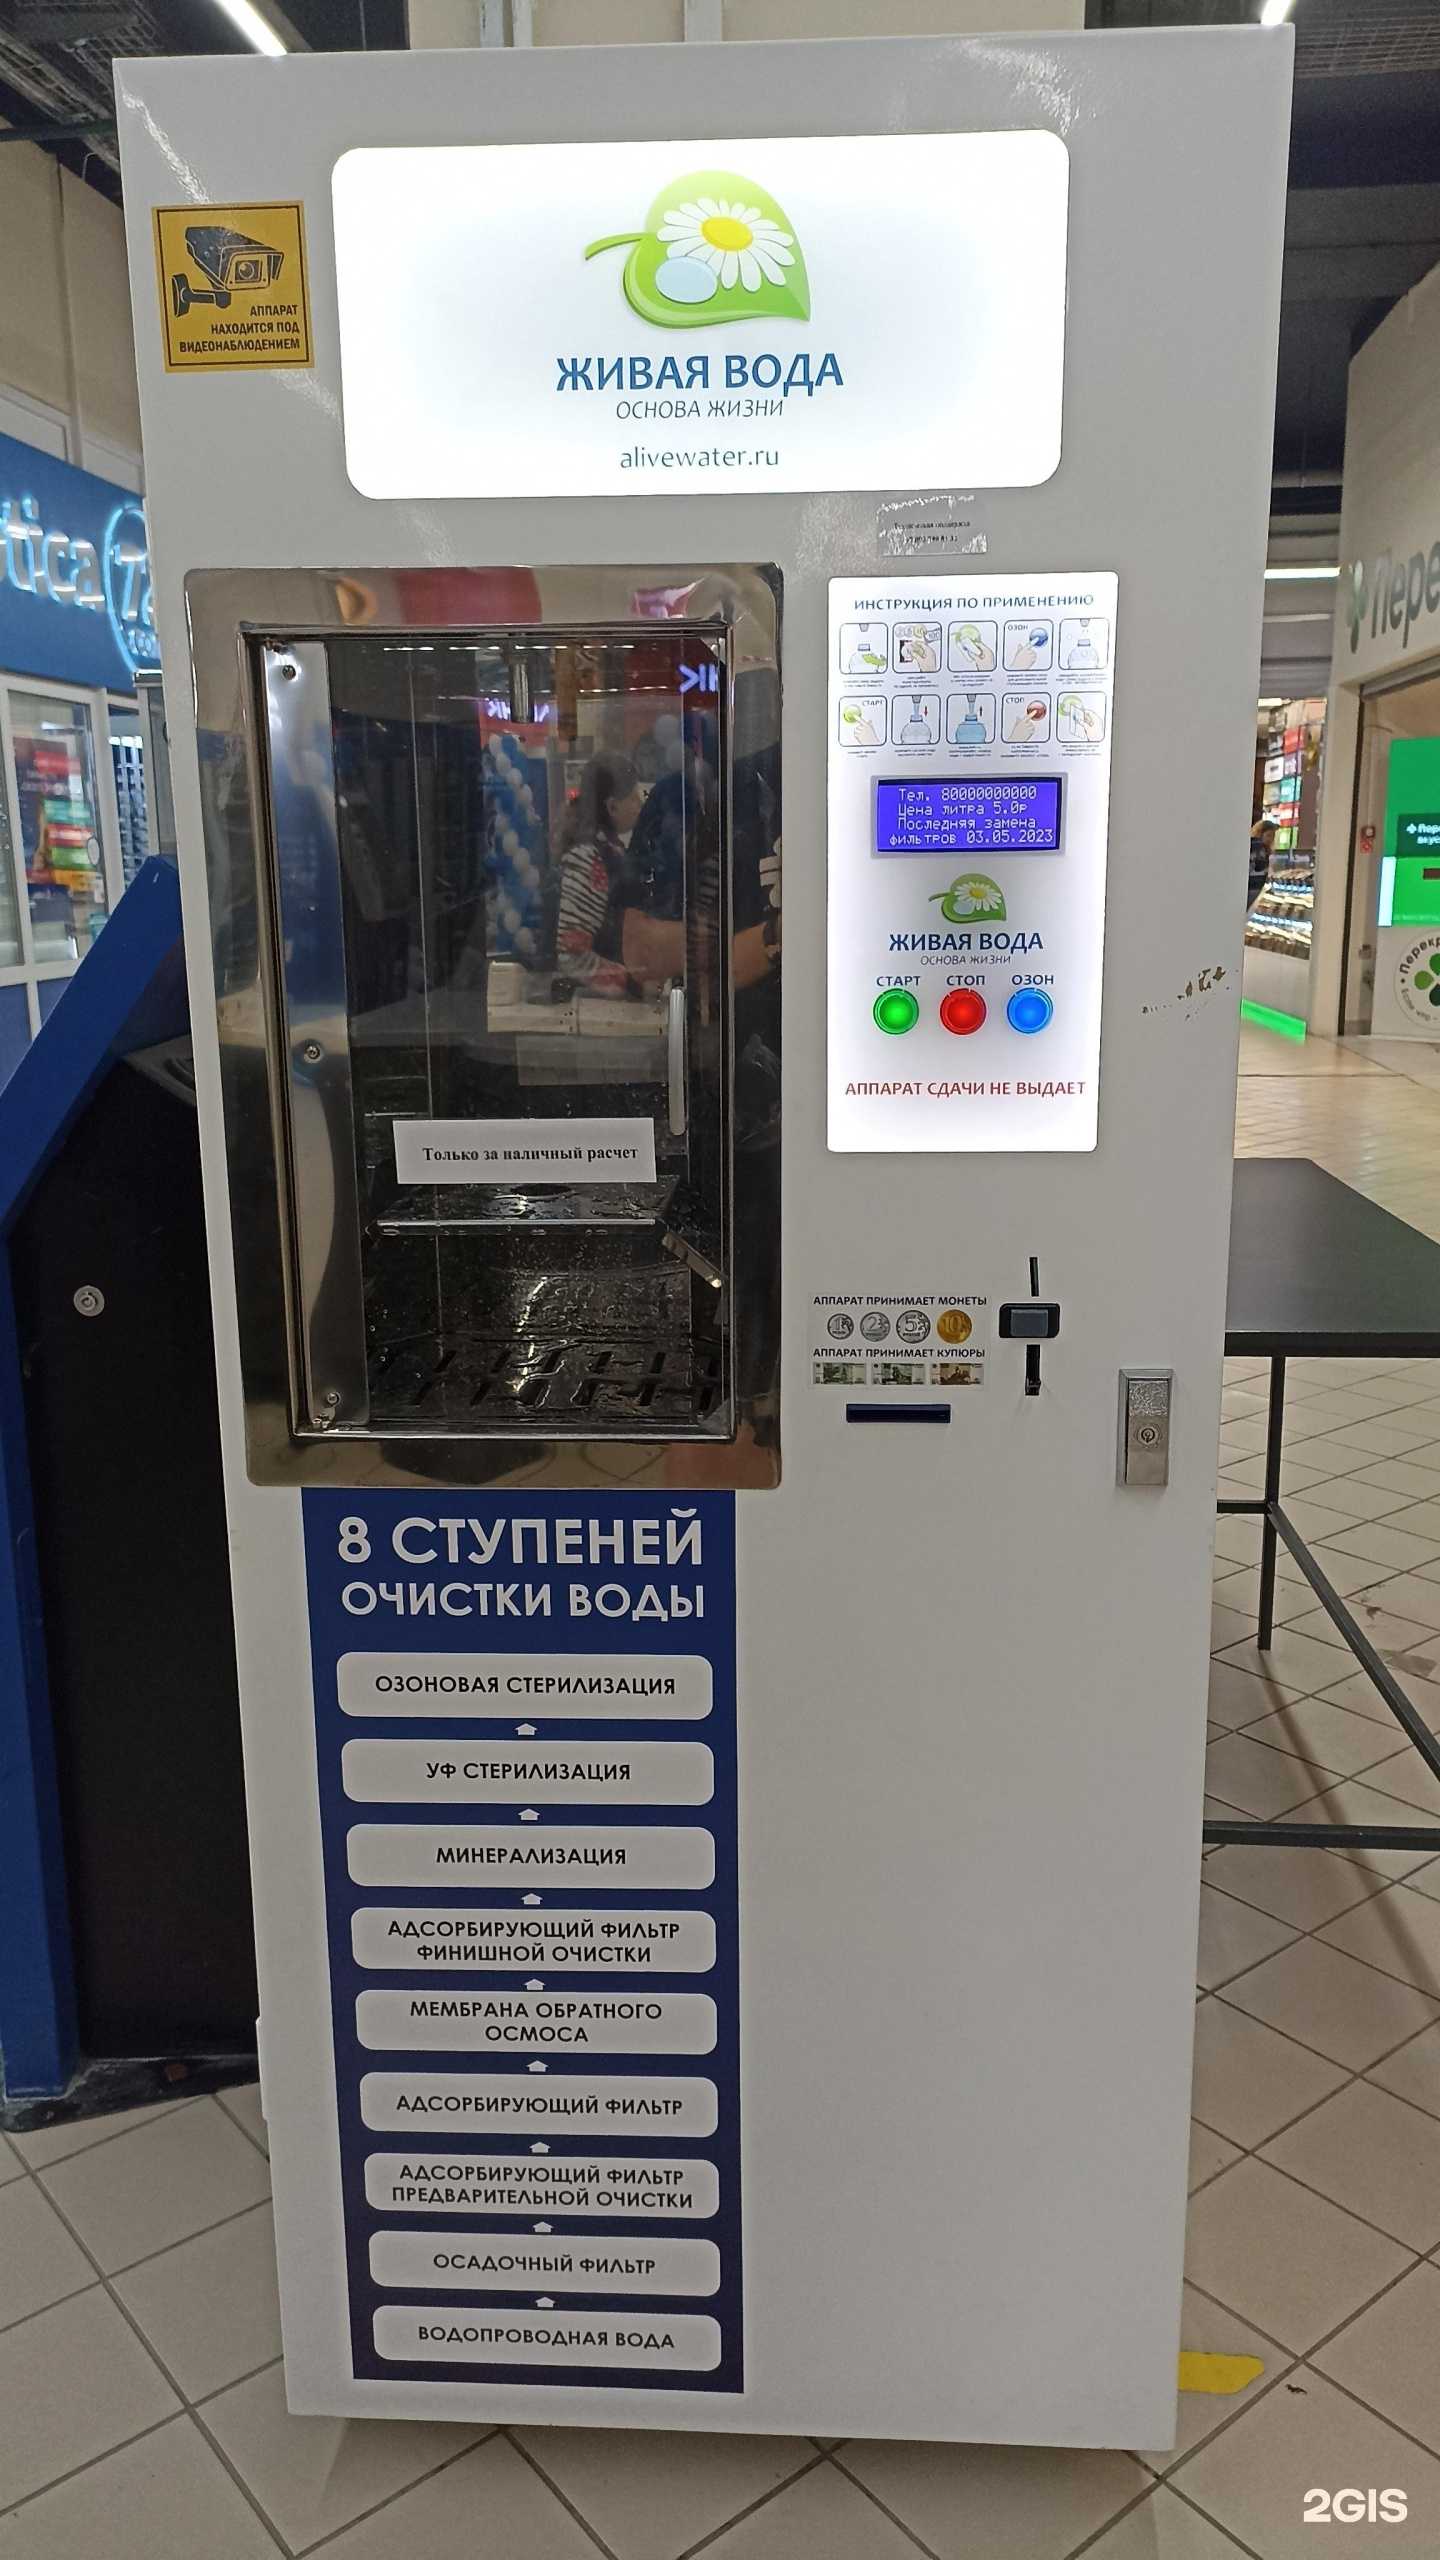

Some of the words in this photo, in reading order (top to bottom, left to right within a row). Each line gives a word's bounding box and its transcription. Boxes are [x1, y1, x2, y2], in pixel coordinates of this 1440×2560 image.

[250, 305, 298, 316] АППАРАТ
[211, 322, 273, 335] НАХОДИТСЯ
[277, 321, 300, 334] ПОД
[179, 338, 300, 353] ВИДЕОНАБЛЮДЕНИЕМ
[556, 355, 709, 391] ЖИВАЯ
[725, 353, 844, 397] ВОДА
[616, 400, 700, 419] ОСНОВА
[707, 399, 783, 418] ЖИЗНИ
[620, 446, 779, 468] alivewater.ru
[854, 598, 952, 611] ИНСТРУКЦИЯ
[957, 597, 979, 608] ПО
[983, 594, 1094, 608] ПРИМЕНЕНИЮ
[1005, 696, 1025, 704] СТОП
[898, 788, 930, 801] Тел.
[941, 786, 1037, 801] 80000000000
[898, 803, 933, 817] Цена
[942, 804, 984, 815] литра
[898, 817, 976, 831] Последняя
[985, 818, 1036, 829] замена
[966, 829, 1053, 844] 03.05.2023
[889, 933, 972, 951] ЖИВАЯ
[979, 932, 1043, 954] ВОДА
[920, 955, 966, 965] ОСНОВА
[970, 955, 1011, 964] ЖИЗНИ
[876, 975, 921, 987] СТАРТ
[946, 975, 985, 986] СТОП
[1011, 974, 1054, 985] ОЗОН
[845, 1082, 923, 1096] АППАРАТ
[927, 1082, 984, 1098] СДАЧИ
[990, 1082, 1011, 1094] НЕ
[1016, 1081, 1086, 1097] ВЫДАЕТ
[422, 1148, 478, 1161] Только
[483, 1150, 498, 1160] за
[503, 1147, 583, 1160] наличный
[587, 1149, 639, 1162] расчет
[813, 1296, 863, 1305] АППАРАТ
[866, 1296, 936, 1305] ПРИНИМАЕТ
[938, 1296, 987, 1305] МОНЕТЫ
[813, 1349, 862, 1358] АППАРАТ
[866, 1349, 934, 1358] ПРИНИМАЕТ
[937, 1349, 985, 1358] КУПЮРЫ
[337, 1516, 372, 1563] 8
[392, 1508, 702, 1565] СТУПЕНЕЙ
[341, 1582, 552, 1616] ОЧИСТКИ
[569, 1584, 704, 1622] ВОДЫ
[375, 1676, 499, 1693] ОЗОНОВАЯ
[506, 1677, 676, 1696] СТЕРИЛИЗАЦИЯ
[426, 1762, 456, 1779] УФ
[463, 1763, 631, 1783] СТЕРИЛИЗАЦИЯ
[436, 1847, 627, 1867] МИНЕРАЛИЗАЦИЯ
[388, 1919, 594, 1940] АДСОРБИРУЮЩИЙ
[601, 1923, 680, 1939] ФИЛЬТР
[417, 1942, 545, 1963] ФИНИШНОЙ
[552, 1946, 651, 1963] ОЧИСТКИ
[410, 2001, 529, 2018] МЕМБРАНА
[536, 2003, 662, 2020] ОБРАТНОГО
[485, 2026, 589, 2043] ОСМОСА
[396, 2095, 599, 2115] АДСОРБИРУЮЩИЙ
[605, 2098, 683, 2115] ФИЛЬТР
[400, 2164, 600, 2185] АДСОРБИРУЮЩИЙ
[607, 2169, 684, 2185] ФИЛЬТР
[392, 2187, 589, 2207] ПРЕДВАРИТЕЛЬНОЙ
[596, 2191, 693, 2208] ОЧИСТКИ
[433, 2253, 573, 2272] ОСАДОЧНЫЙ
[580, 2257, 656, 2274] ФИЛЬТР
[418, 2326, 608, 2346] ВОДОПРОВОДНАЯ
[615, 2331, 675, 2348] ВОДА
